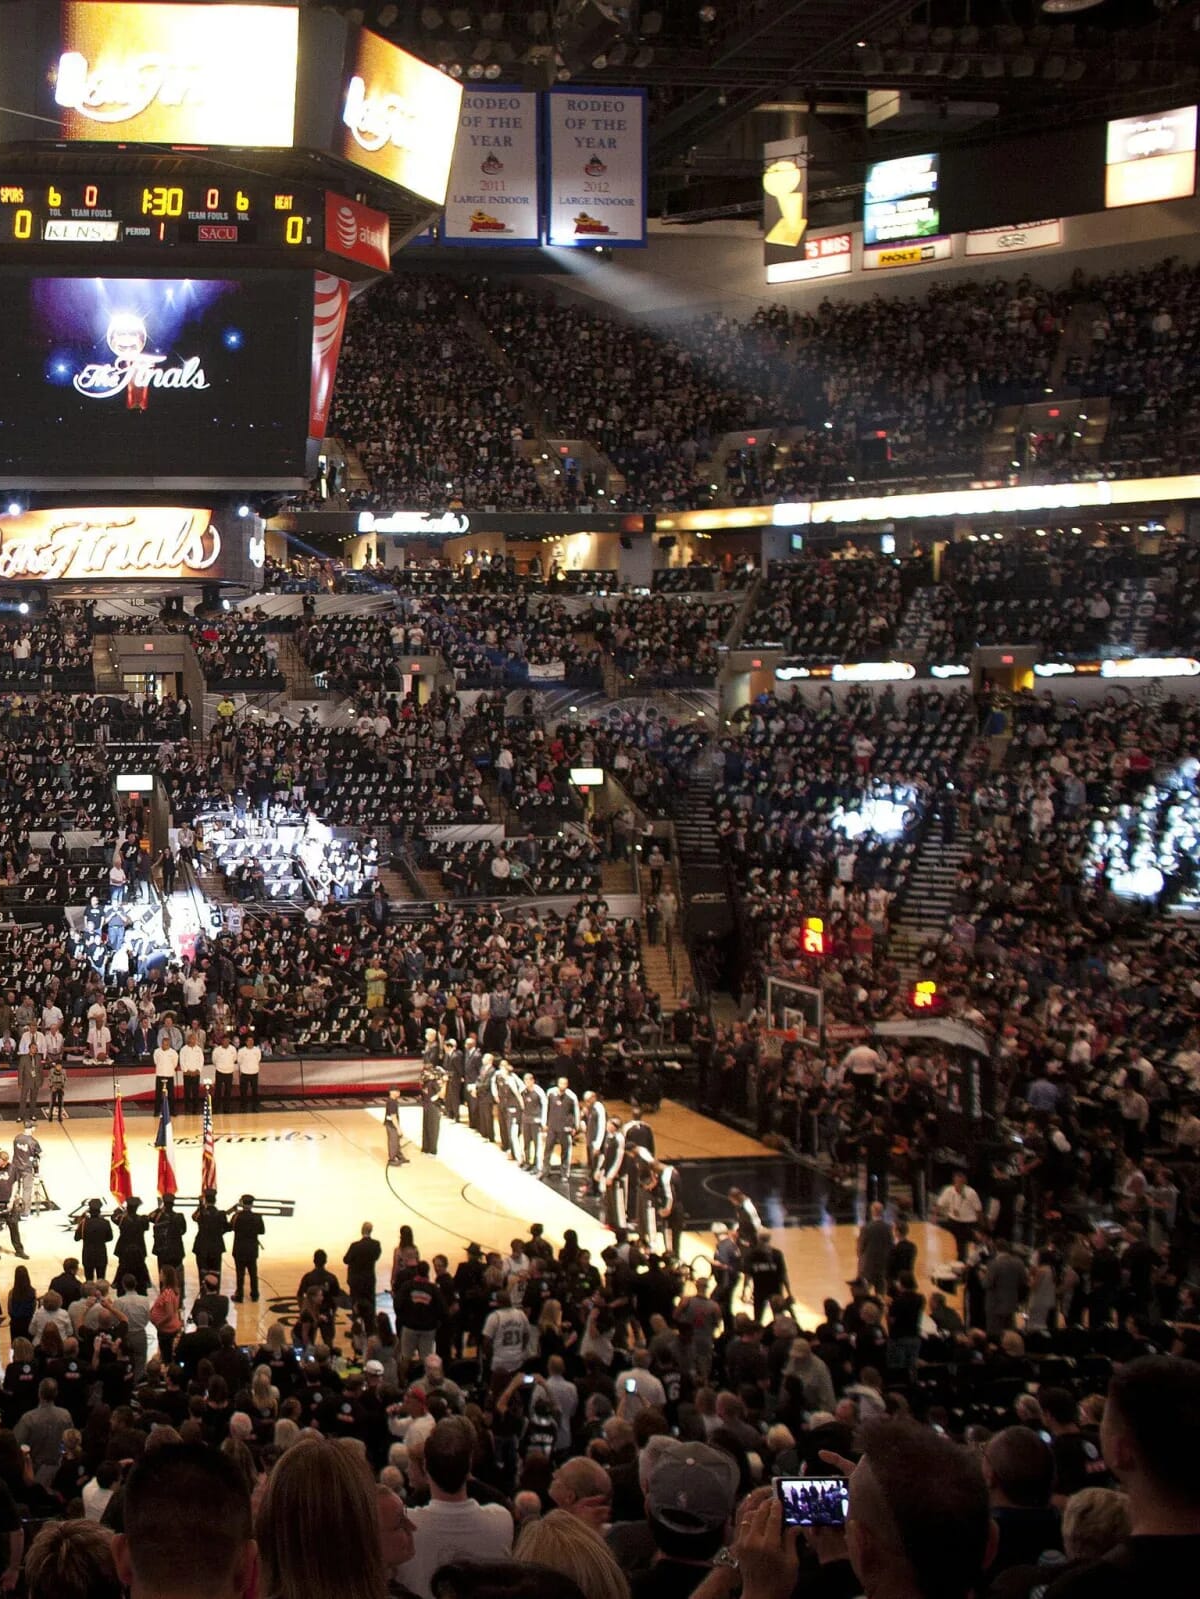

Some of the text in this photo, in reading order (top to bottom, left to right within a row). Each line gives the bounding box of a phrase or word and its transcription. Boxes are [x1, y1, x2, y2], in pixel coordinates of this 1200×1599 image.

[463, 98, 521, 110] RODEO
[568, 100, 625, 113] RODEO
[461, 116, 522, 129] OF THE
[565, 119, 627, 131] OF THE
[470, 135, 512, 147] YEAR
[574, 136, 617, 149] YEAR
[479, 180, 506, 191] 2011
[583, 182, 611, 193] 2012
[0, 187, 24, 203] SPURS
[85, 185, 97, 207] 0
[206, 189, 219, 209] 0
[453, 195, 529, 205] LARGE INDOOR
[143, 188, 183, 216] 1:30
[275, 195, 293, 210] HEAT
[559, 197, 635, 207] LARGE INDOOR
[71, 209, 112, 217] TEAM FOULS
[188, 211, 229, 221] TEAM FOULS
[14, 209, 32, 238] 0
[286, 216, 303, 244] 0
[125, 227, 150, 236] PERIOD
[199, 227, 237, 240] SACU
[881, 252, 917, 263] HOLT
[114, 353, 211, 390] Finals
[50, 514, 220, 579] Finals
[503, 1330, 521, 1346] 21
